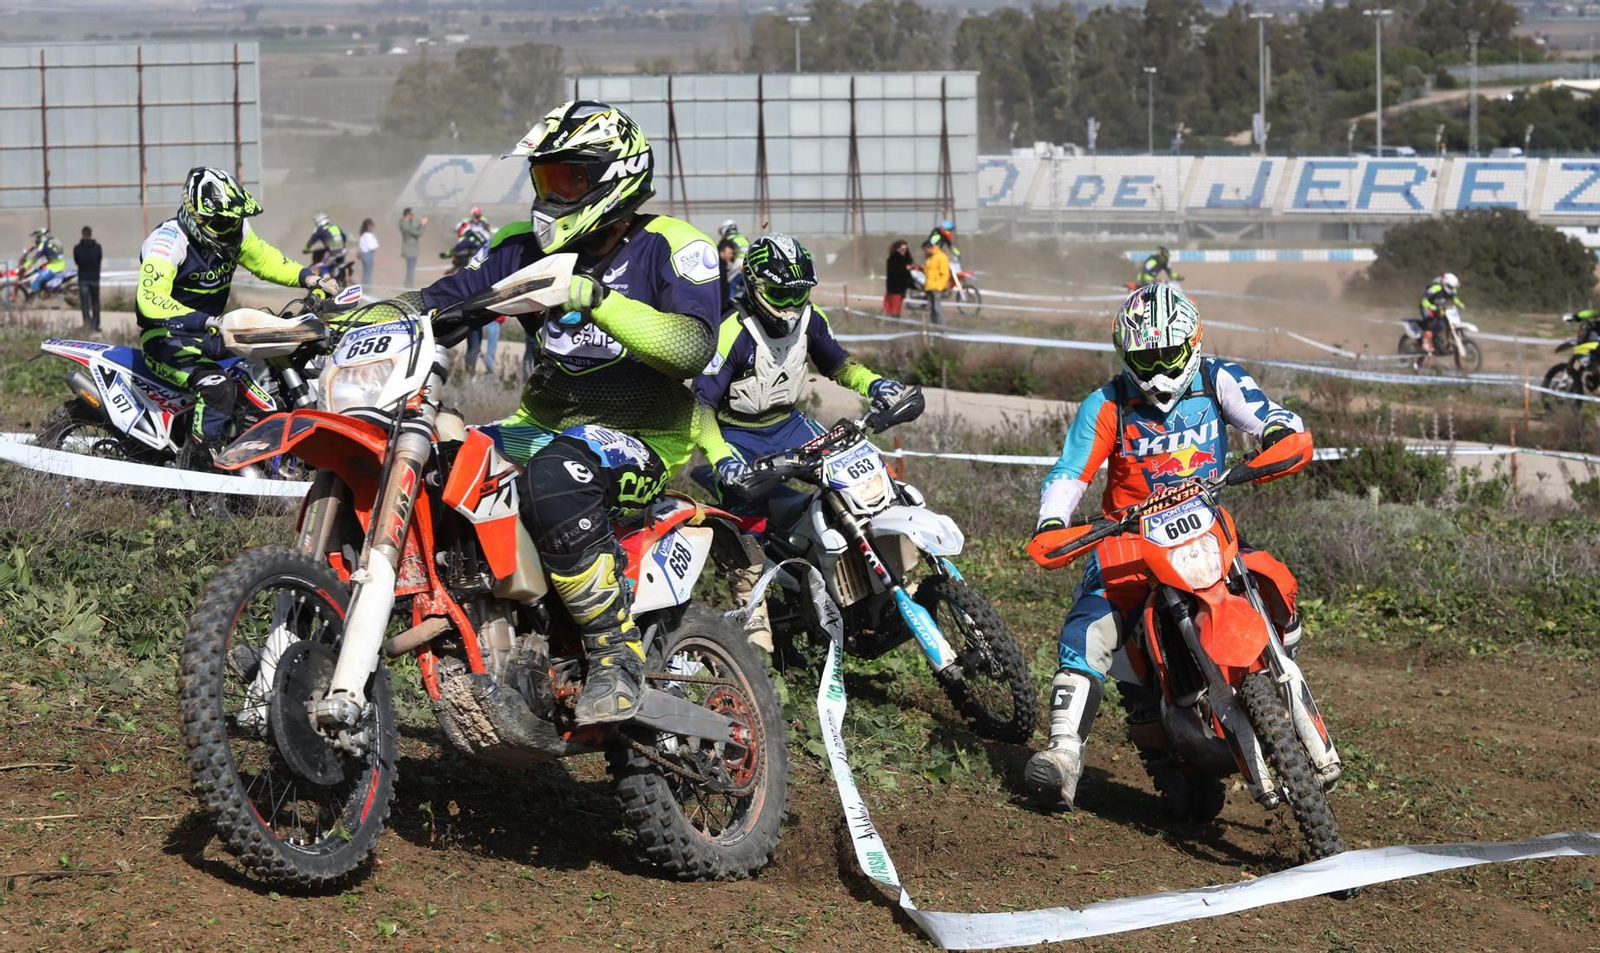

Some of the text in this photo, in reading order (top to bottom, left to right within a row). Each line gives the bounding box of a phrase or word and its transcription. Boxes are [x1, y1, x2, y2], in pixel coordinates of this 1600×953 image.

[1067, 175, 1154, 207] DE
[1205, 161, 1600, 211] JEREZ
[680, 251, 700, 262] CLUB
[360, 326, 382, 336] PONT
[571, 331, 616, 349] GRUP
[345, 335, 393, 360] 658
[111, 393, 133, 414] 677
[1138, 418, 1219, 457] KINI
[846, 457, 875, 481] 653
[1161, 506, 1181, 519] PONT
[1181, 500, 1202, 512] GRUP
[1164, 513, 1202, 540] 600
[669, 542, 693, 579] 658
[899, 602, 939, 651] DUNLOP
[826, 683, 842, 703] NO
[865, 850, 884, 875] PASAR
